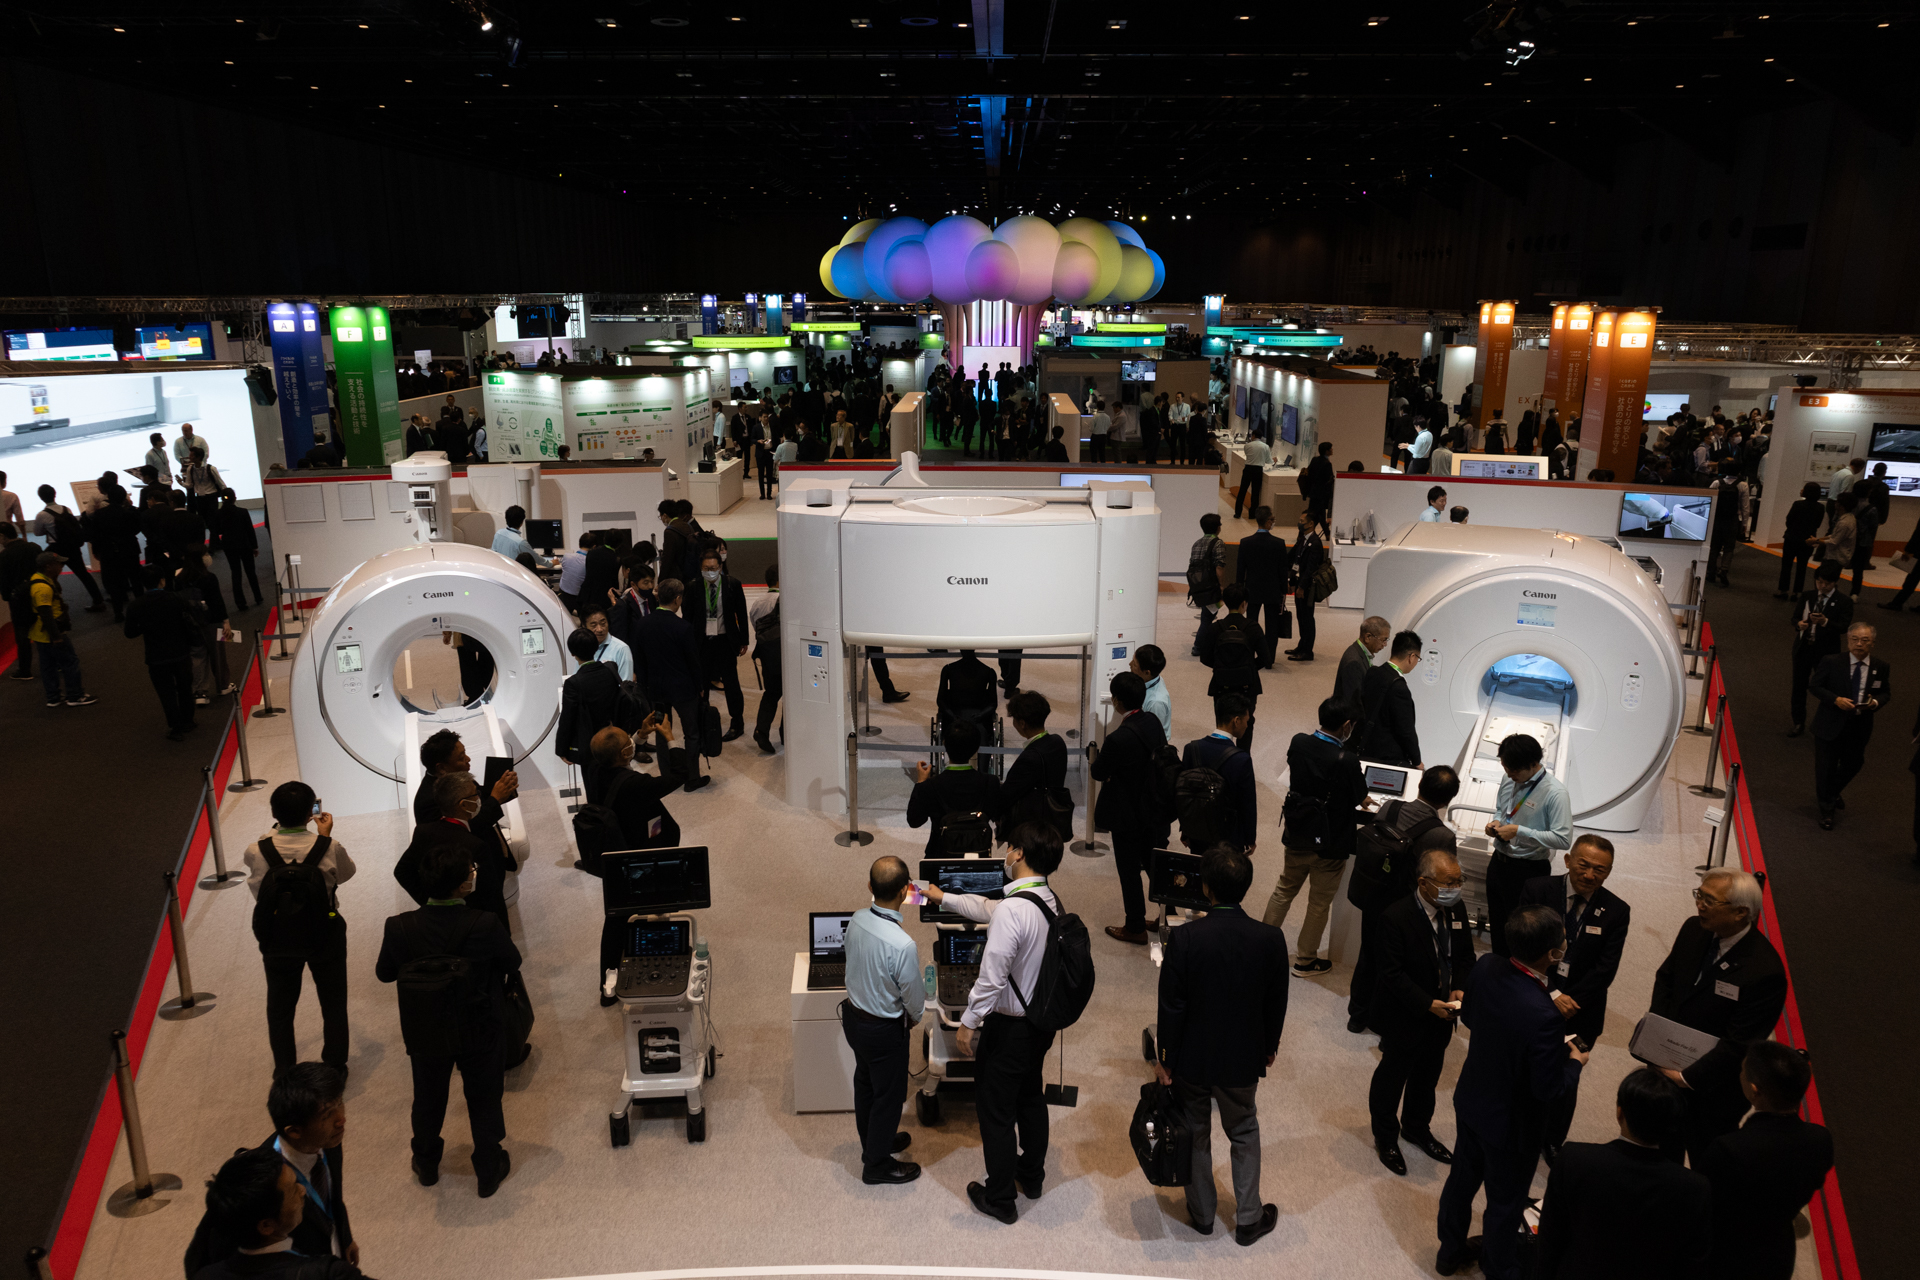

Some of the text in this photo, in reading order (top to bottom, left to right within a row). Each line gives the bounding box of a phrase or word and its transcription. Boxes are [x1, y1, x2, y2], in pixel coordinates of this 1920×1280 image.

[281, 322, 288, 330] A
[1630, 336, 1637, 345] E
[1612, 396, 1626, 454] 社会の安全を守る
[1621, 396, 1635, 447] ひとりの安心と
[946, 575, 989, 586] Canon
[422, 590, 454, 600] Canon
[1522, 590, 1557, 600] Canon
